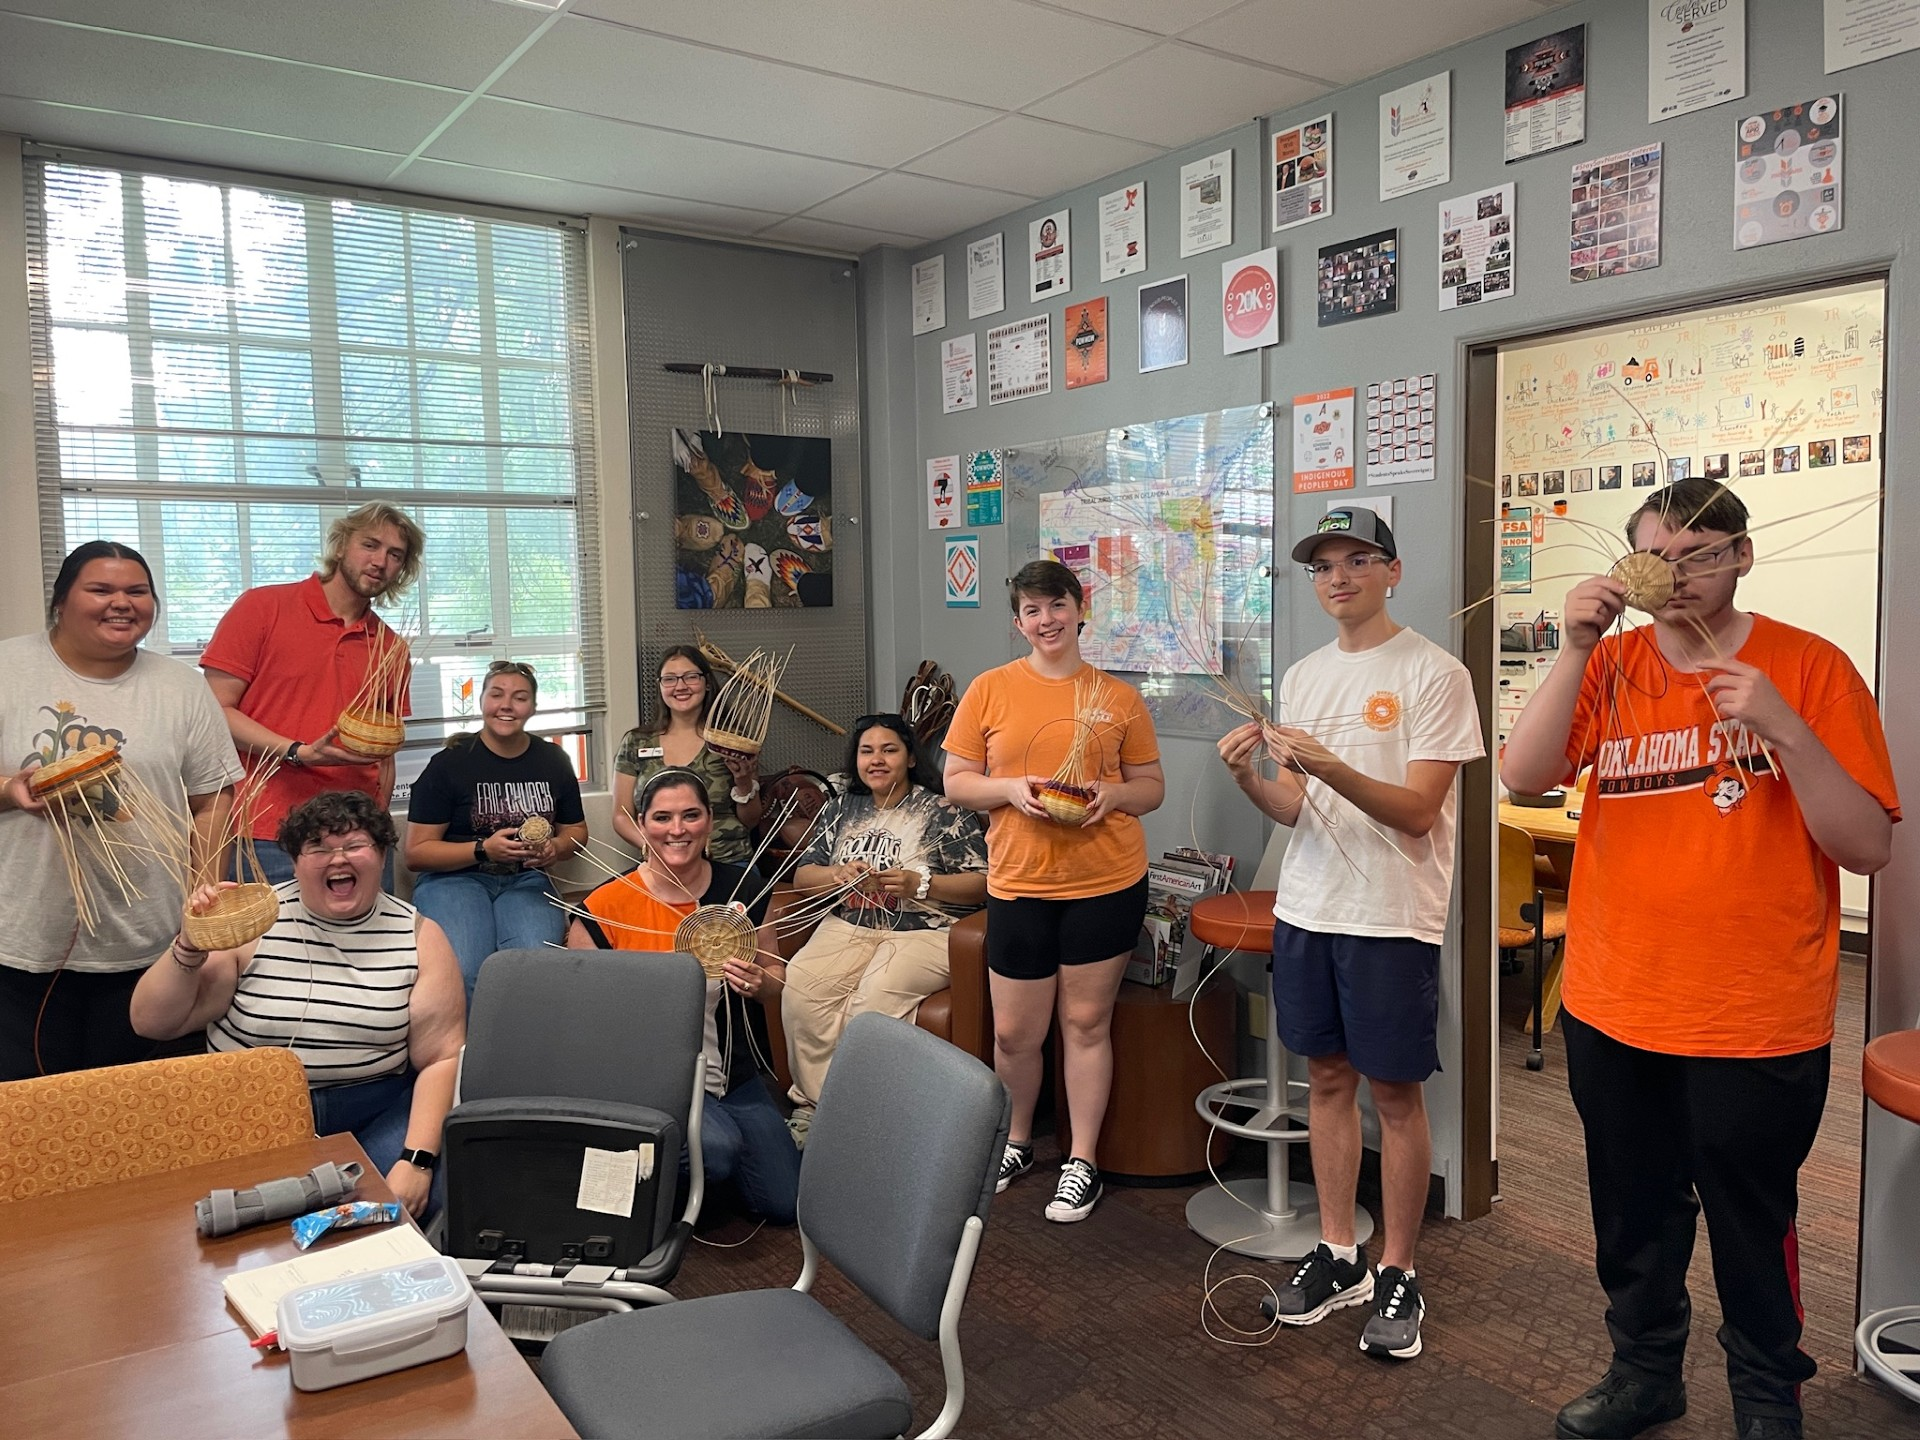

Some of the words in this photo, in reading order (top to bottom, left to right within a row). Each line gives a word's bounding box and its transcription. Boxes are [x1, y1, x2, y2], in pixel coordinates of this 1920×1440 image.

[1676, 0, 1728, 24] SERVED
[1236, 286, 1264, 315] 20K
[1301, 469, 1346, 481] INDIGENOUS
[1334, 478, 1349, 488] DAY
[1503, 521, 1528, 532] FSA
[1509, 538, 1528, 546] NOW
[1598, 725, 1700, 778] OKLAHOMA
[1707, 717, 1776, 763] STA
[476, 782, 504, 815] ERIC
[505, 781, 554, 814] CHURCH
[839, 836, 902, 860] ROLLING
